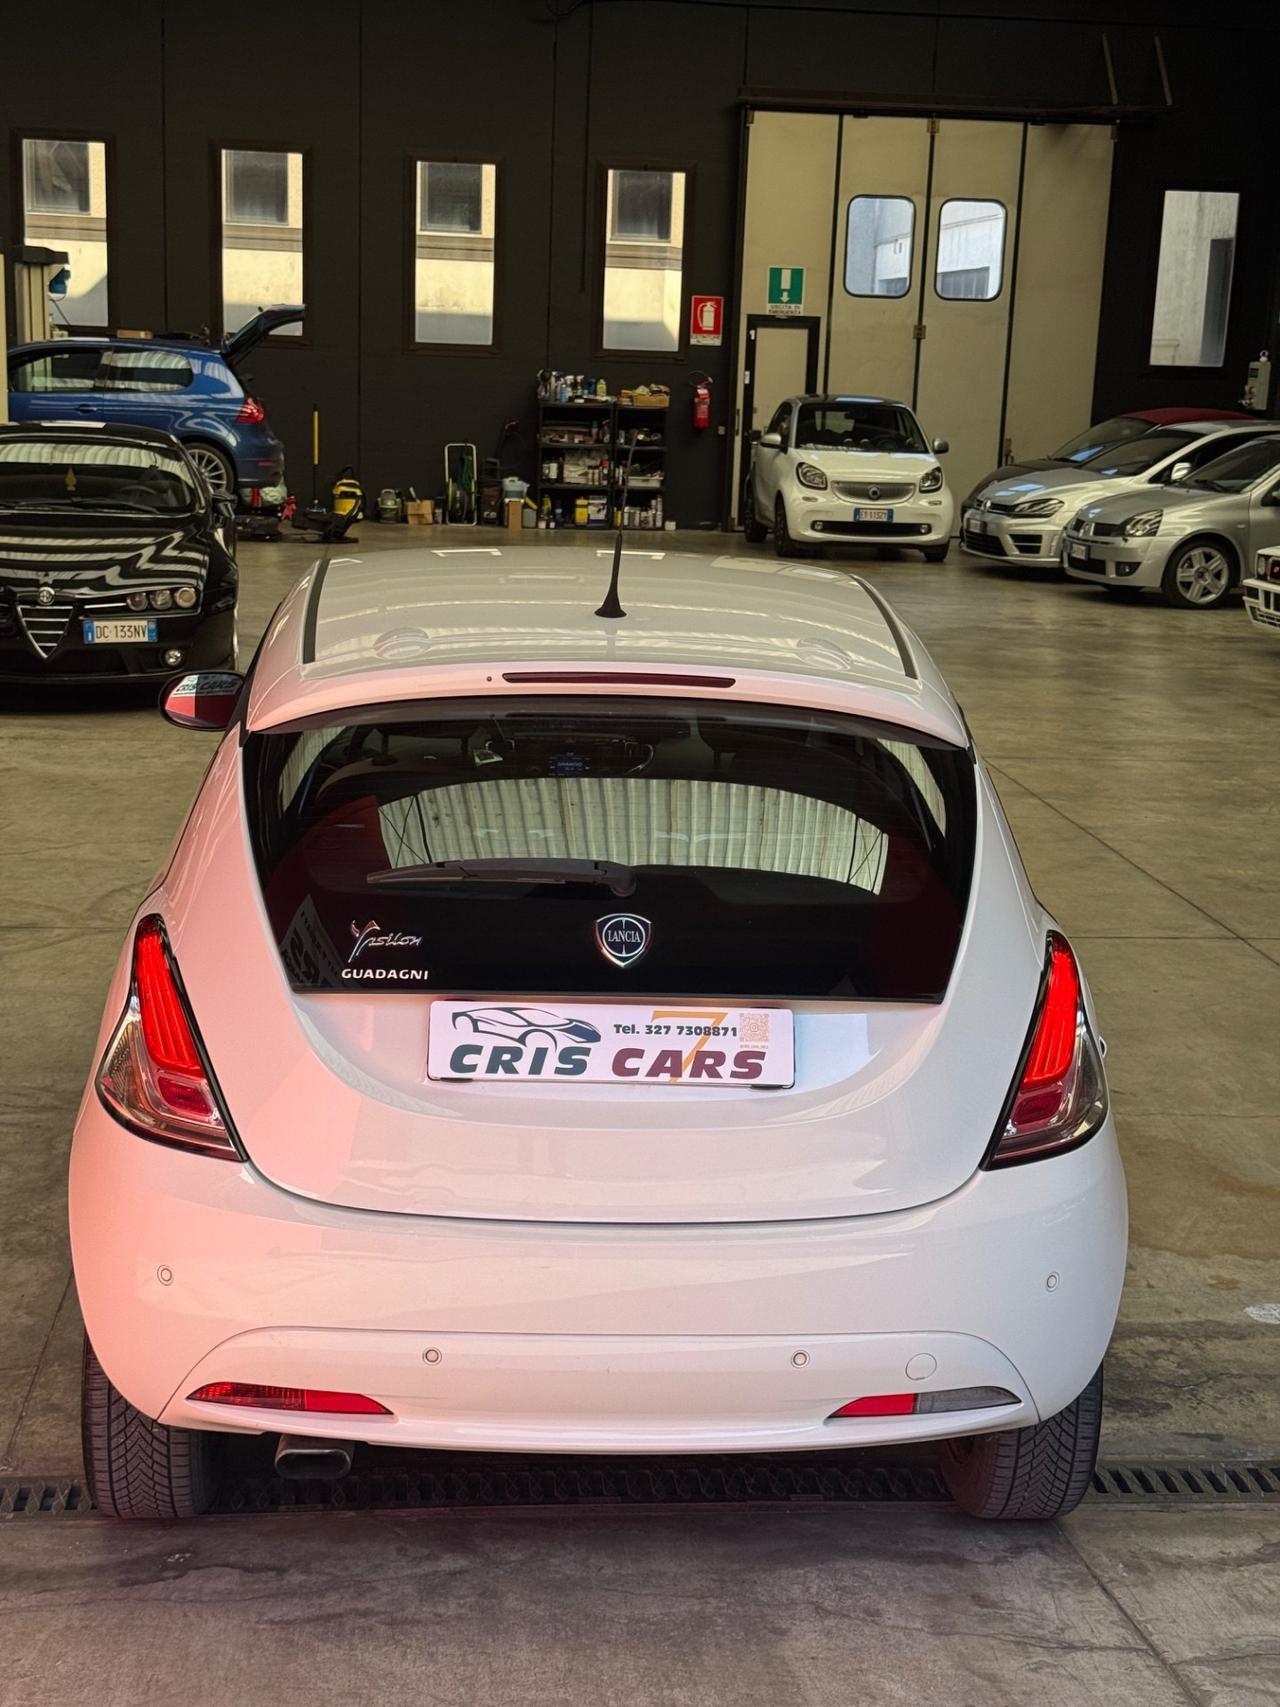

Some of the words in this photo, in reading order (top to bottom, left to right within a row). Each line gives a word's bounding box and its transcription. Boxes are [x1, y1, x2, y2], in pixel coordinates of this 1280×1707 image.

[95, 625, 110, 640] DC
[114, 624, 147, 639] 133NV
[347, 919, 424, 963] Ypsilon
[607, 930, 642, 944] LANCIA
[341, 968, 430, 981] GUADAGNI
[613, 1023, 640, 1036] Tel.
[645, 1024, 671, 1036] 327
[676, 1025, 738, 1037] 7308871
[449, 1044, 592, 1076] CRIS
[611, 1047, 767, 1080] CARS
